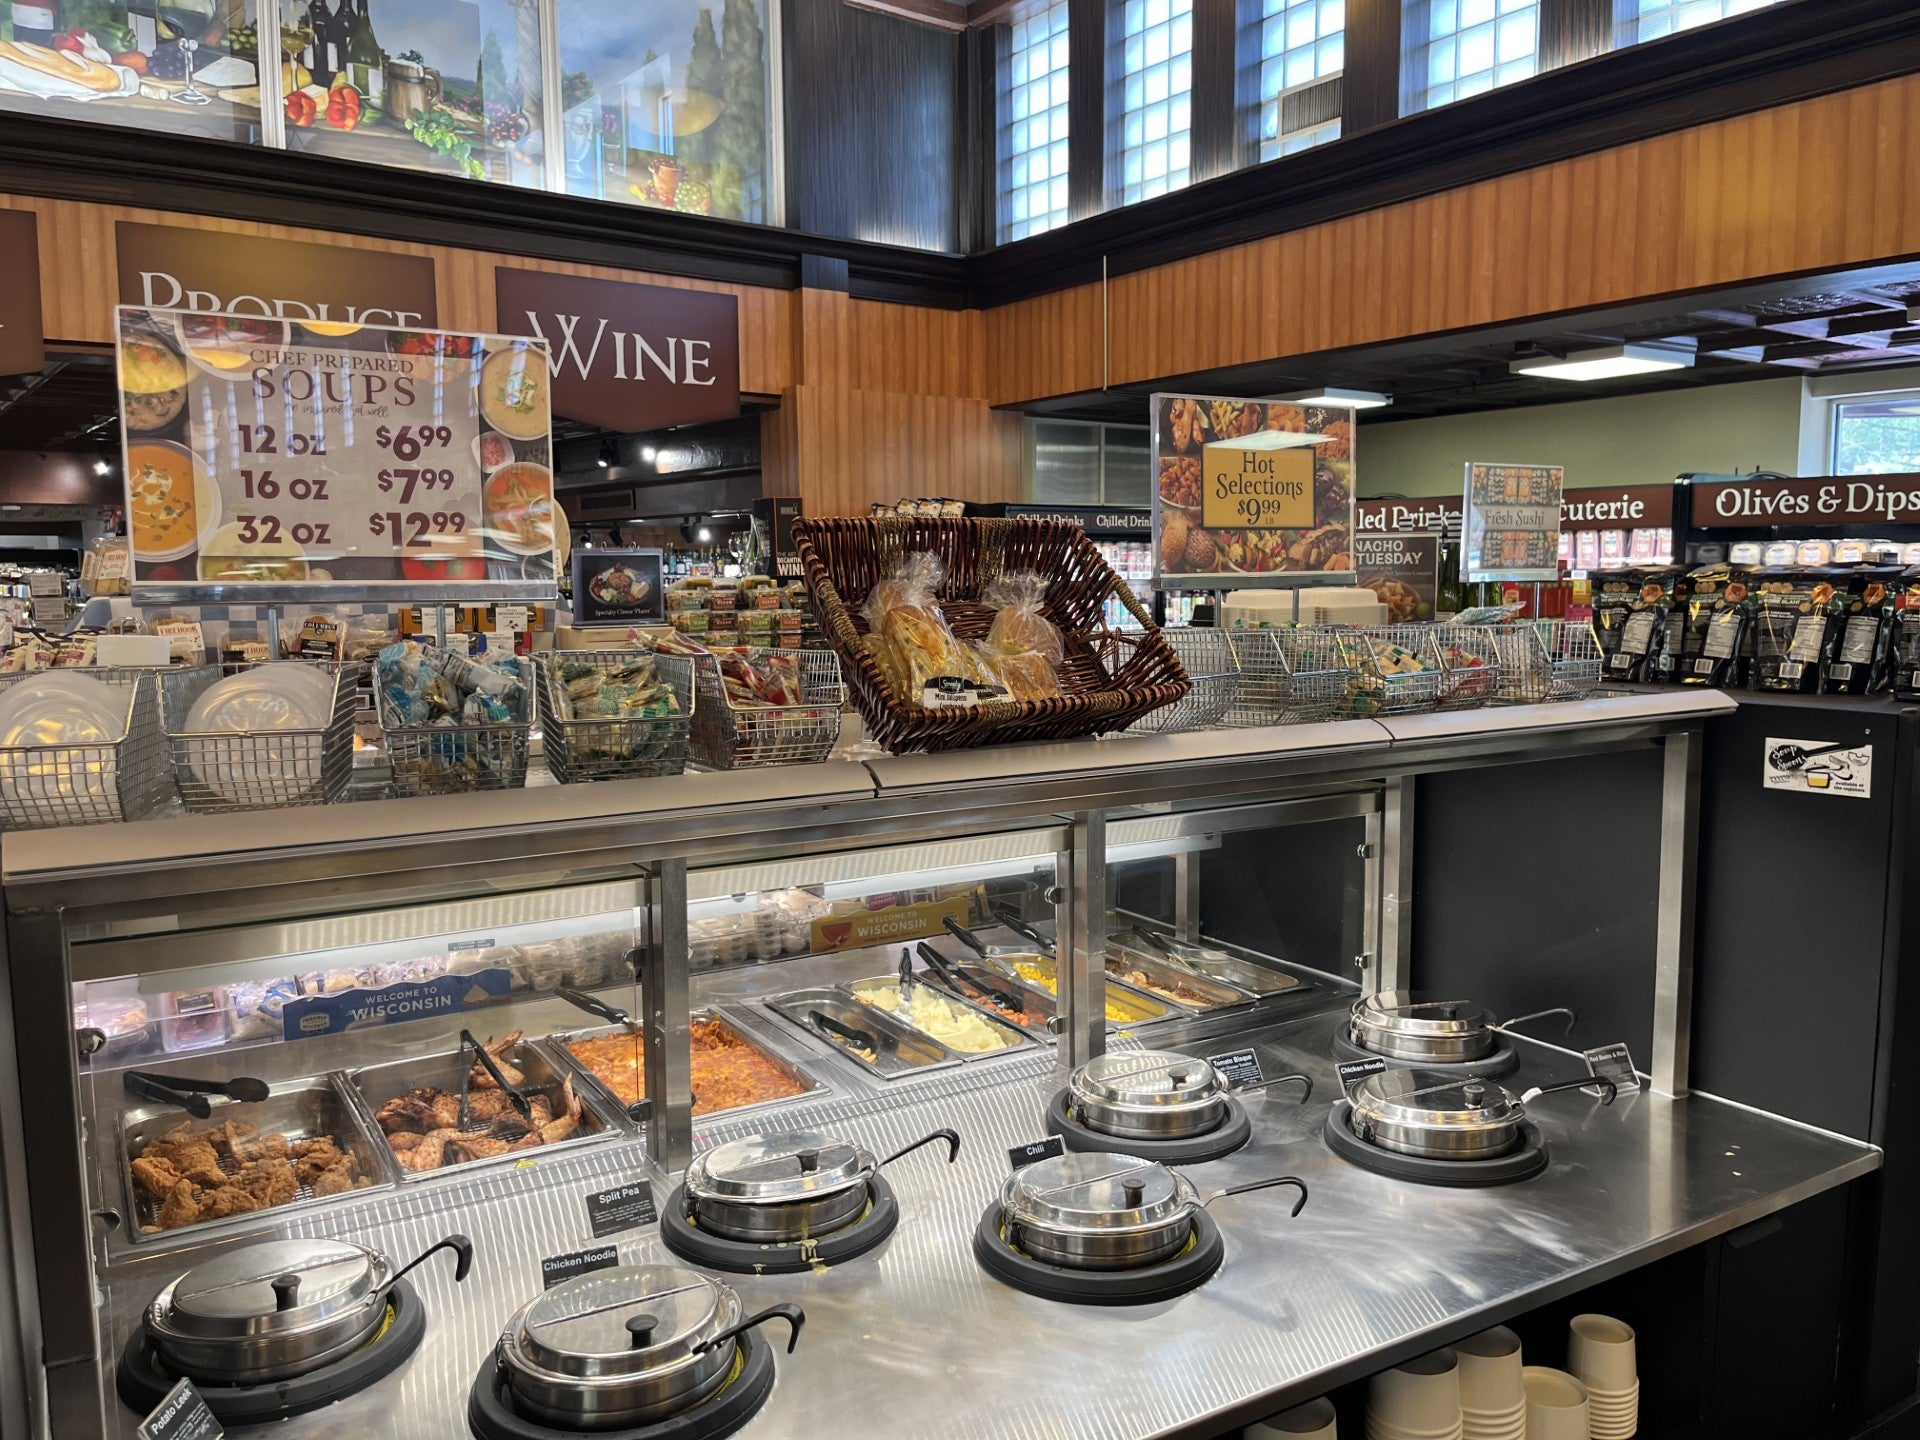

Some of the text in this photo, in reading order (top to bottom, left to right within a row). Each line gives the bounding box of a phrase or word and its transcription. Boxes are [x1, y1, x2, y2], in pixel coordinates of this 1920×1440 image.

[525, 310, 716, 386] WINE
[250, 349, 414, 374] CHEF PREPARED
[252, 366, 416, 407] SOUPS
[238, 424, 277, 454] 12
[287, 432, 327, 456] oz
[1242, 451, 1275, 474] Hot
[240, 469, 454, 504] 16 oz $799
[1216, 473, 1303, 500] Selections
[1715, 482, 1920, 520] Olives & Dips
[1053, 514, 1084, 527] Drinks
[1096, 515, 1129, 528] Chilled
[1485, 509, 1545, 528] Fresh Sushi
[236, 515, 282, 545] 32
[291, 523, 331, 545] oz
[1356, 540, 1404, 552] NACHO
[1356, 552, 1424, 565] TUESDAY
[1771, 744, 1798, 760] Soup
[1777, 753, 1808, 772] Spoons
[858, 918, 927, 937] WISCONSIN
[867, 913, 905, 924] WELCOME
[365, 987, 437, 1004] WELCOME TO
[352, 994, 452, 1021] WISCONSIN
[1340, 1062, 1385, 1074] Chicken Noodle
[1027, 1144, 1045, 1156] Chili
[599, 1186, 640, 1204] Split Pea
[543, 1250, 617, 1271] Chicken Noodle
[151, 1407, 176, 1435] Potato
[173, 1387, 192, 1409] Leek
